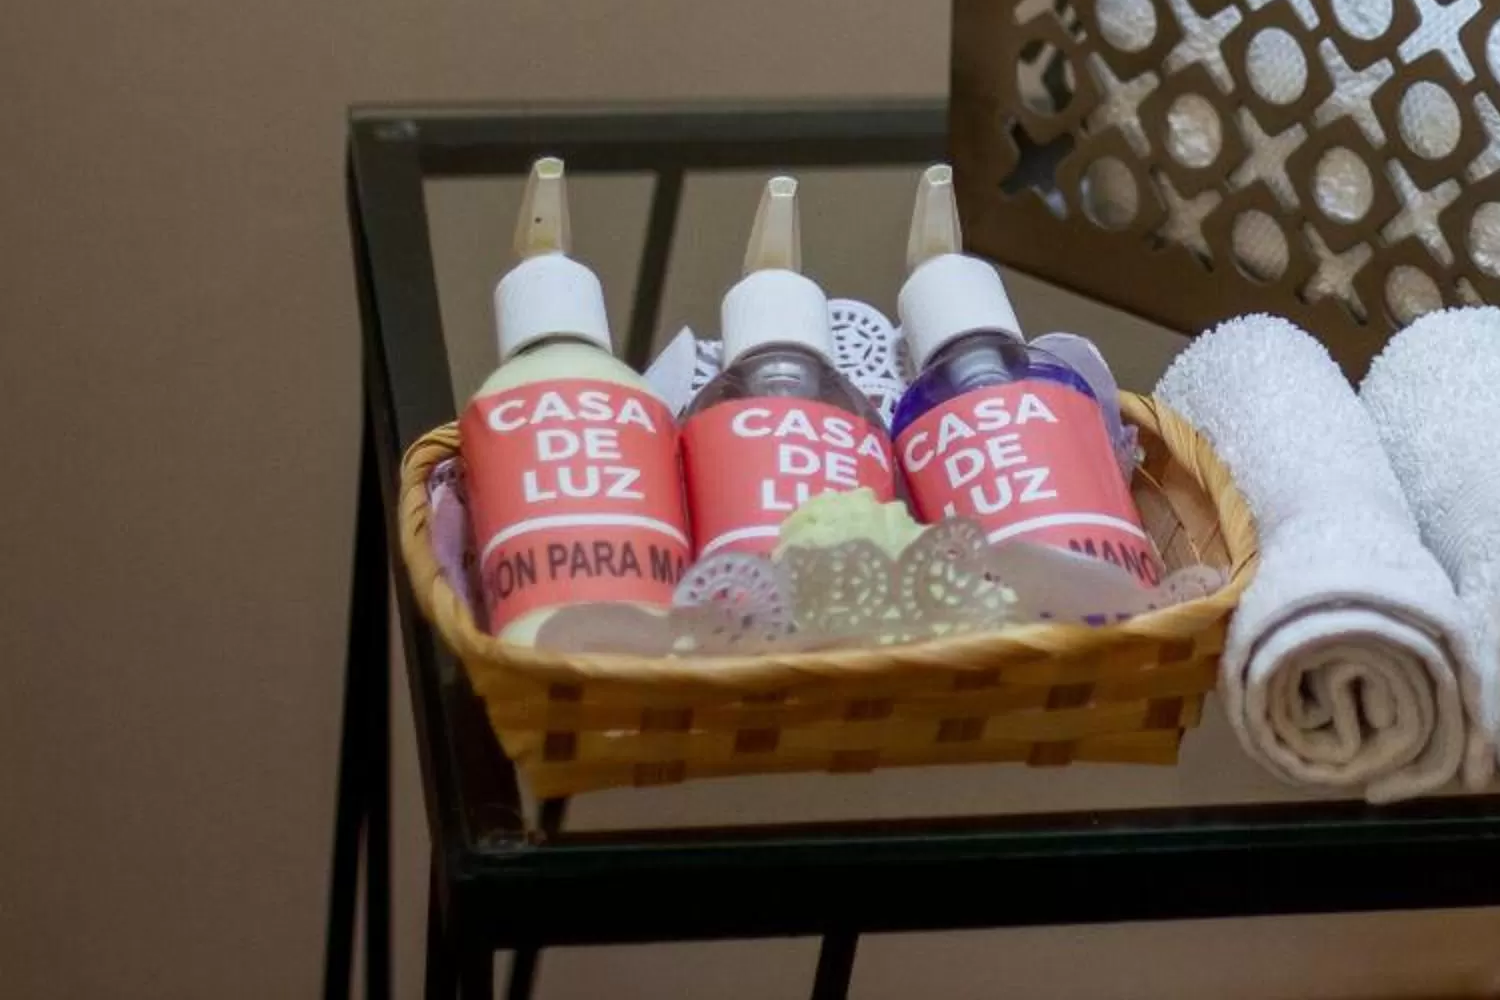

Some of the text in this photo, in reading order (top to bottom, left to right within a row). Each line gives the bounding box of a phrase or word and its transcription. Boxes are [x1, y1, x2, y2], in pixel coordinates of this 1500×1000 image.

[487, 391, 656, 434] CASA
[904, 393, 1059, 473] CASA
[535, 428, 622, 462] DE
[731, 407, 889, 473] CASA
[944, 433, 1028, 489] DE
[522, 466, 646, 503] LUZ
[779, 443, 860, 488] DE
[546, 540, 642, 581] PARA
